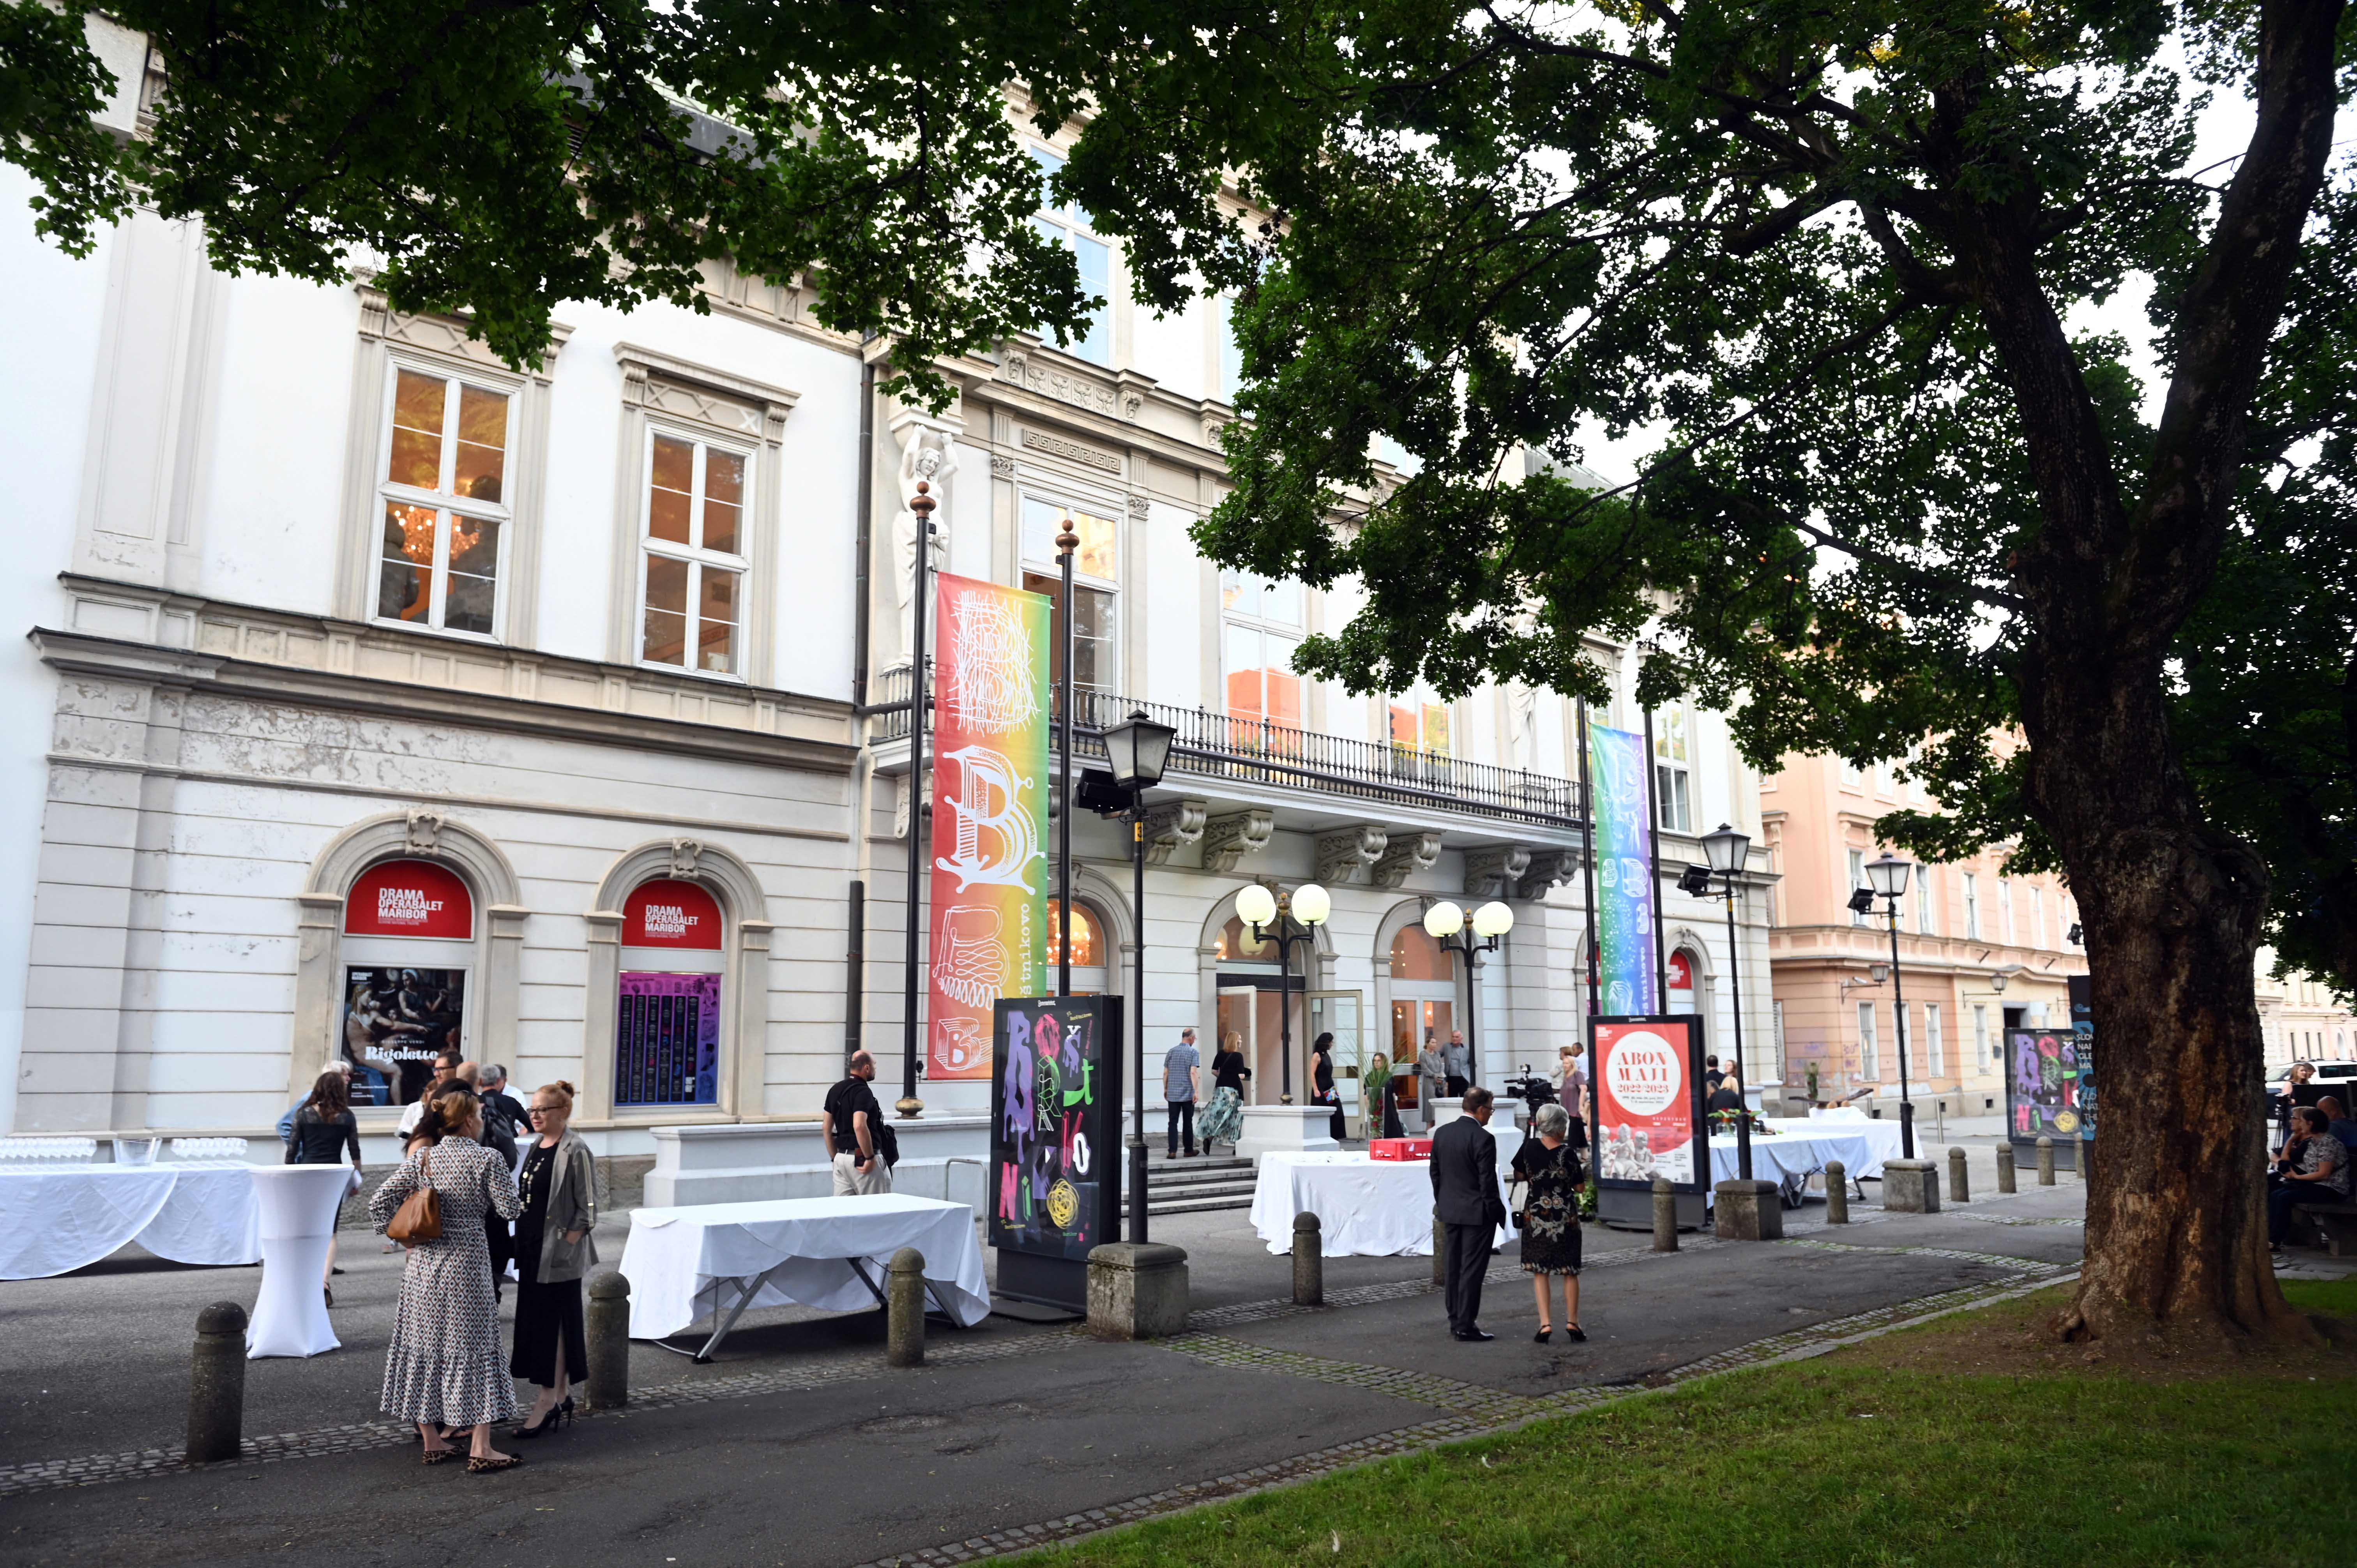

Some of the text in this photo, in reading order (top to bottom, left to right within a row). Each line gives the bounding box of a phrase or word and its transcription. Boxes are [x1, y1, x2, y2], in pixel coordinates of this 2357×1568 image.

[379, 887, 424, 901] DRAMA
[378, 899, 443, 911] OPERABALET
[645, 904, 683, 916] DRAMA
[378, 908, 428, 919] MARIBOR
[645, 915, 699, 925] OPERABALET
[645, 923, 686, 933] MARIBOR
[365, 1046, 439, 1065] Rigoletto
[1618, 1052, 1666, 1065] ABON
[1618, 1068, 1668, 1081] MAJI
